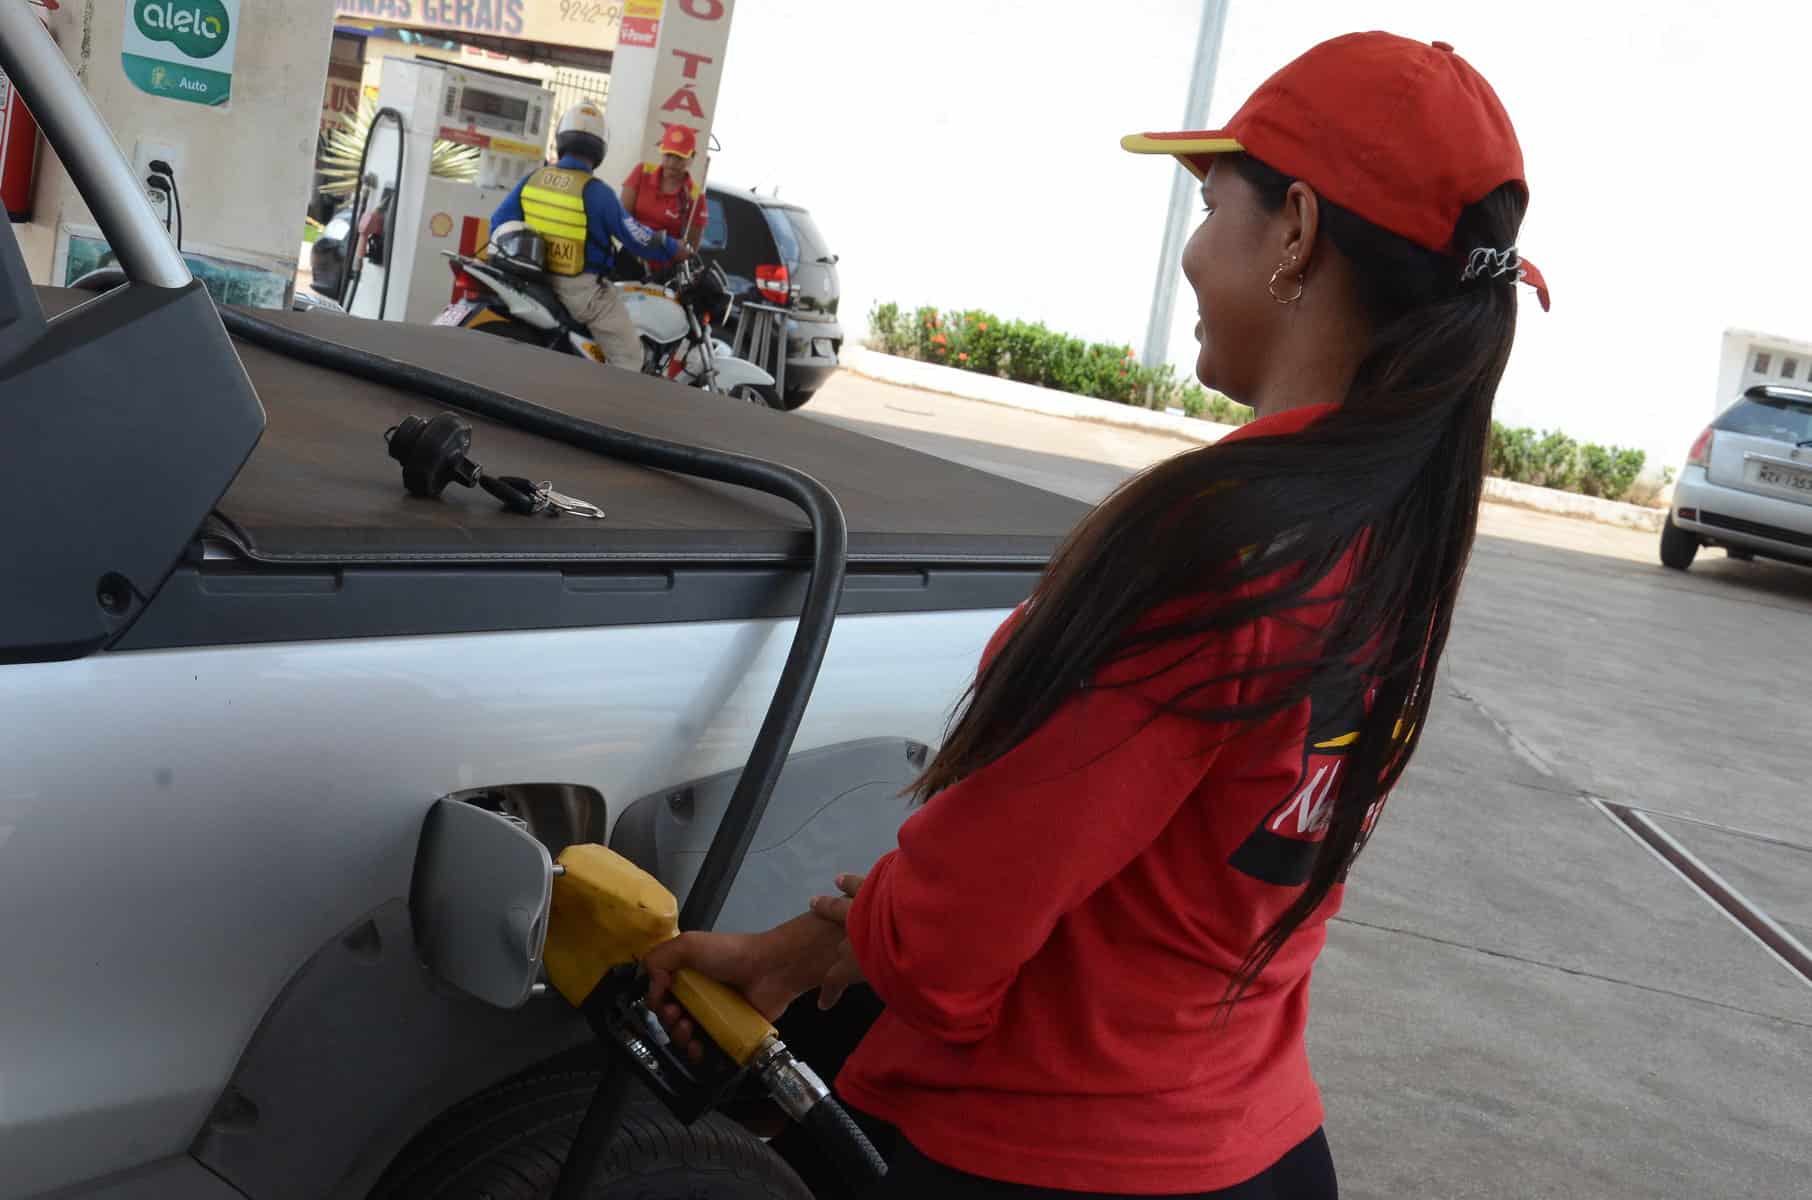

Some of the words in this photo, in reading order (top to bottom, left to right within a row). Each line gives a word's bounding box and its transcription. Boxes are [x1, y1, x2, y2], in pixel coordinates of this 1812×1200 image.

[144, 2, 222, 39] alelo
[421, 0, 525, 34] GERAIS
[179, 77, 208, 92] Auto
